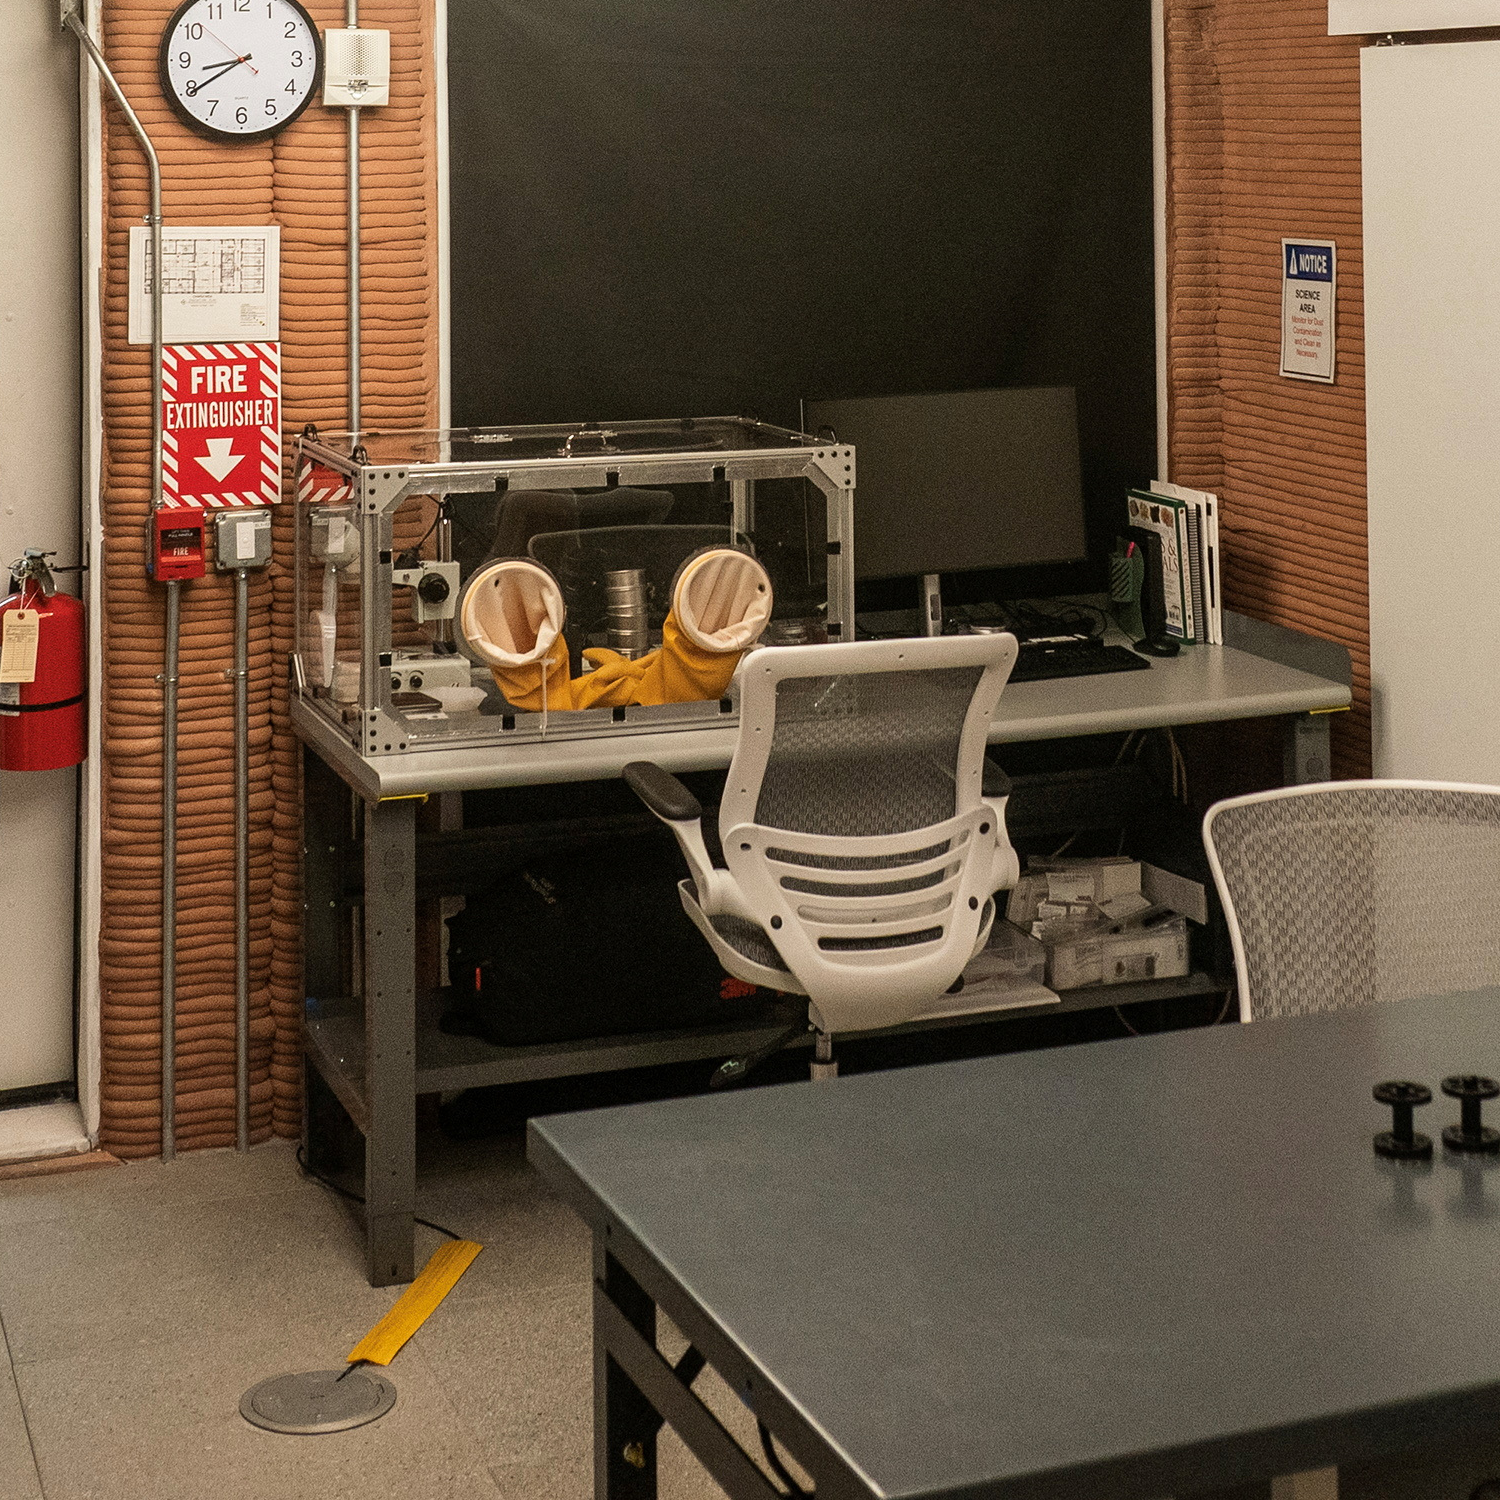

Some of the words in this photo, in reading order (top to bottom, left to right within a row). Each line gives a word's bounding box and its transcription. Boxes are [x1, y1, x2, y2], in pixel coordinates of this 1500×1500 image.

[207, 2, 222, 20] 11
[266, 2, 272, 19] 1
[184, 22, 203, 40] 10
[284, 21, 296, 39] 2
[178, 51, 191, 69] 9
[290, 50, 303, 68] 3
[185, 79, 198, 97] 8
[284, 78, 297, 96] 4
[206, 100, 219, 117] 7
[235, 106, 248, 124] 6
[264, 98, 277, 116] 5
[1299, 253, 1328, 274] NOTICE
[1295, 289, 1321, 301] SCIENCE
[1299, 303, 1316, 314] AREA
[191, 364, 248, 394] FIRE
[166, 399, 273, 429] EXTINGUISHER
[173, 547, 189, 556] FIRE
